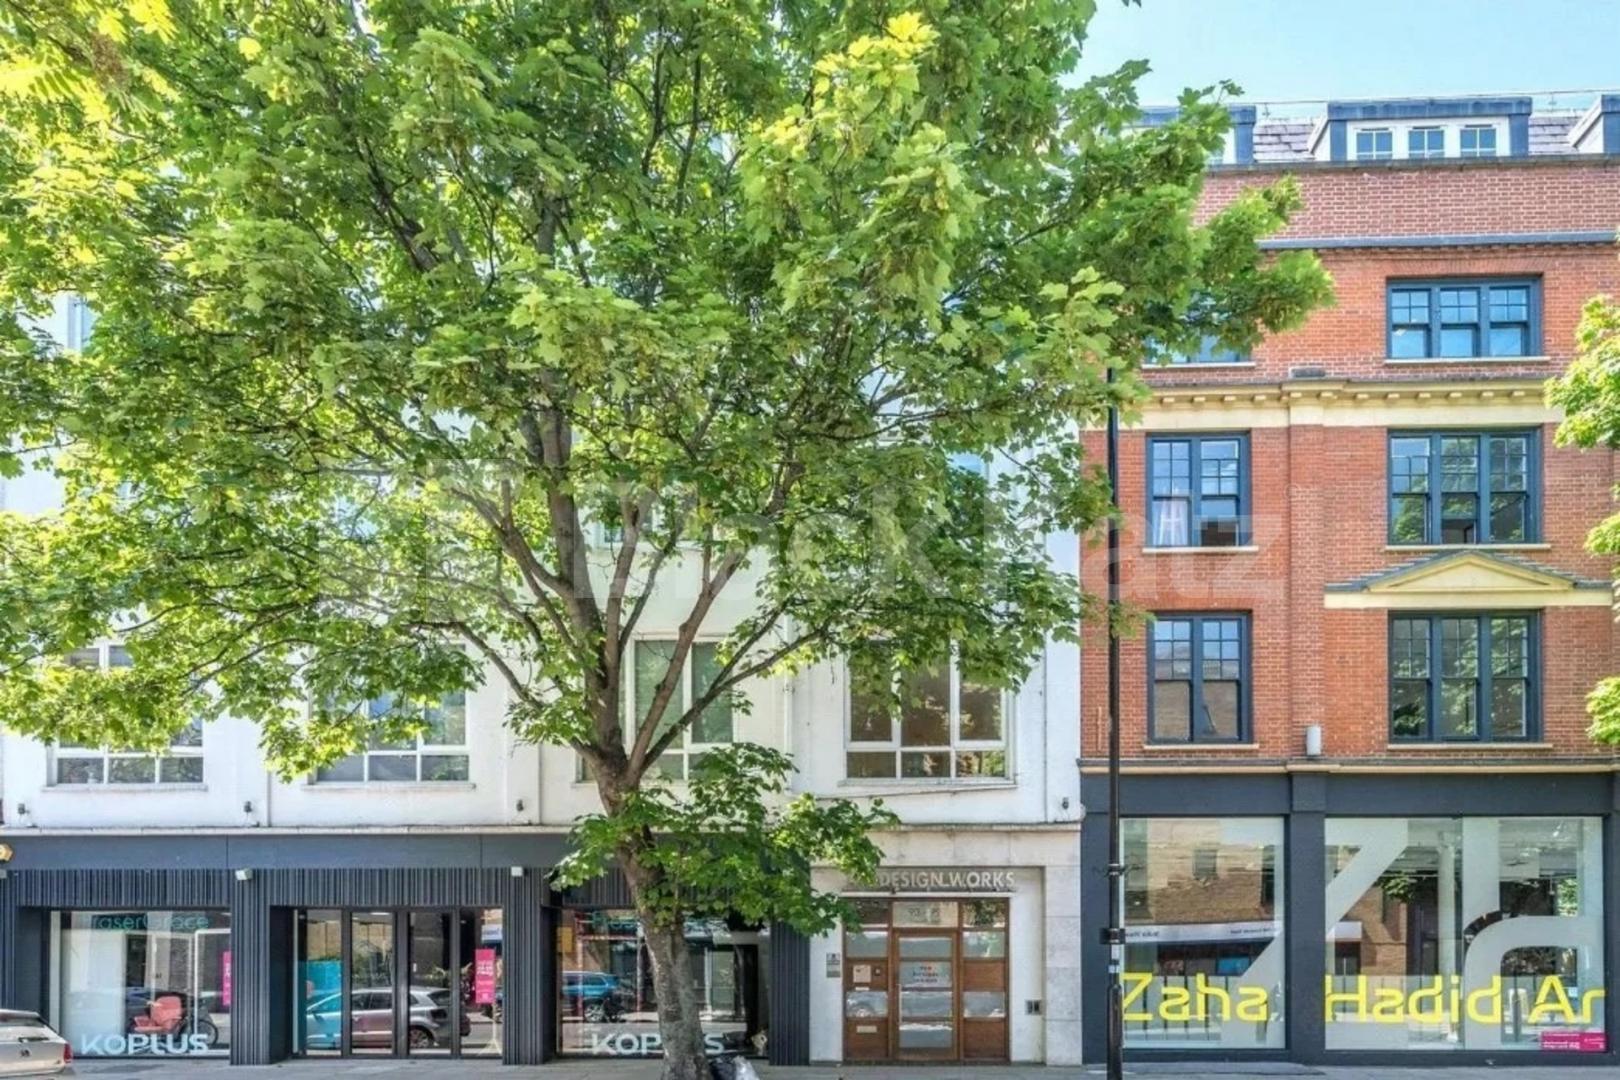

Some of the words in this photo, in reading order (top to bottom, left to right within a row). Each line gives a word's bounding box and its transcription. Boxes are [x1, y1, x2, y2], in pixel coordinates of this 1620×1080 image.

[1121, 972, 1268, 1022] Zaha
[1325, 975, 1501, 1023] Hadid
[1528, 975, 1605, 1023] Ar
[81, 1033, 208, 1055] KOPLUS
[592, 1033, 724, 1055] KOPS
